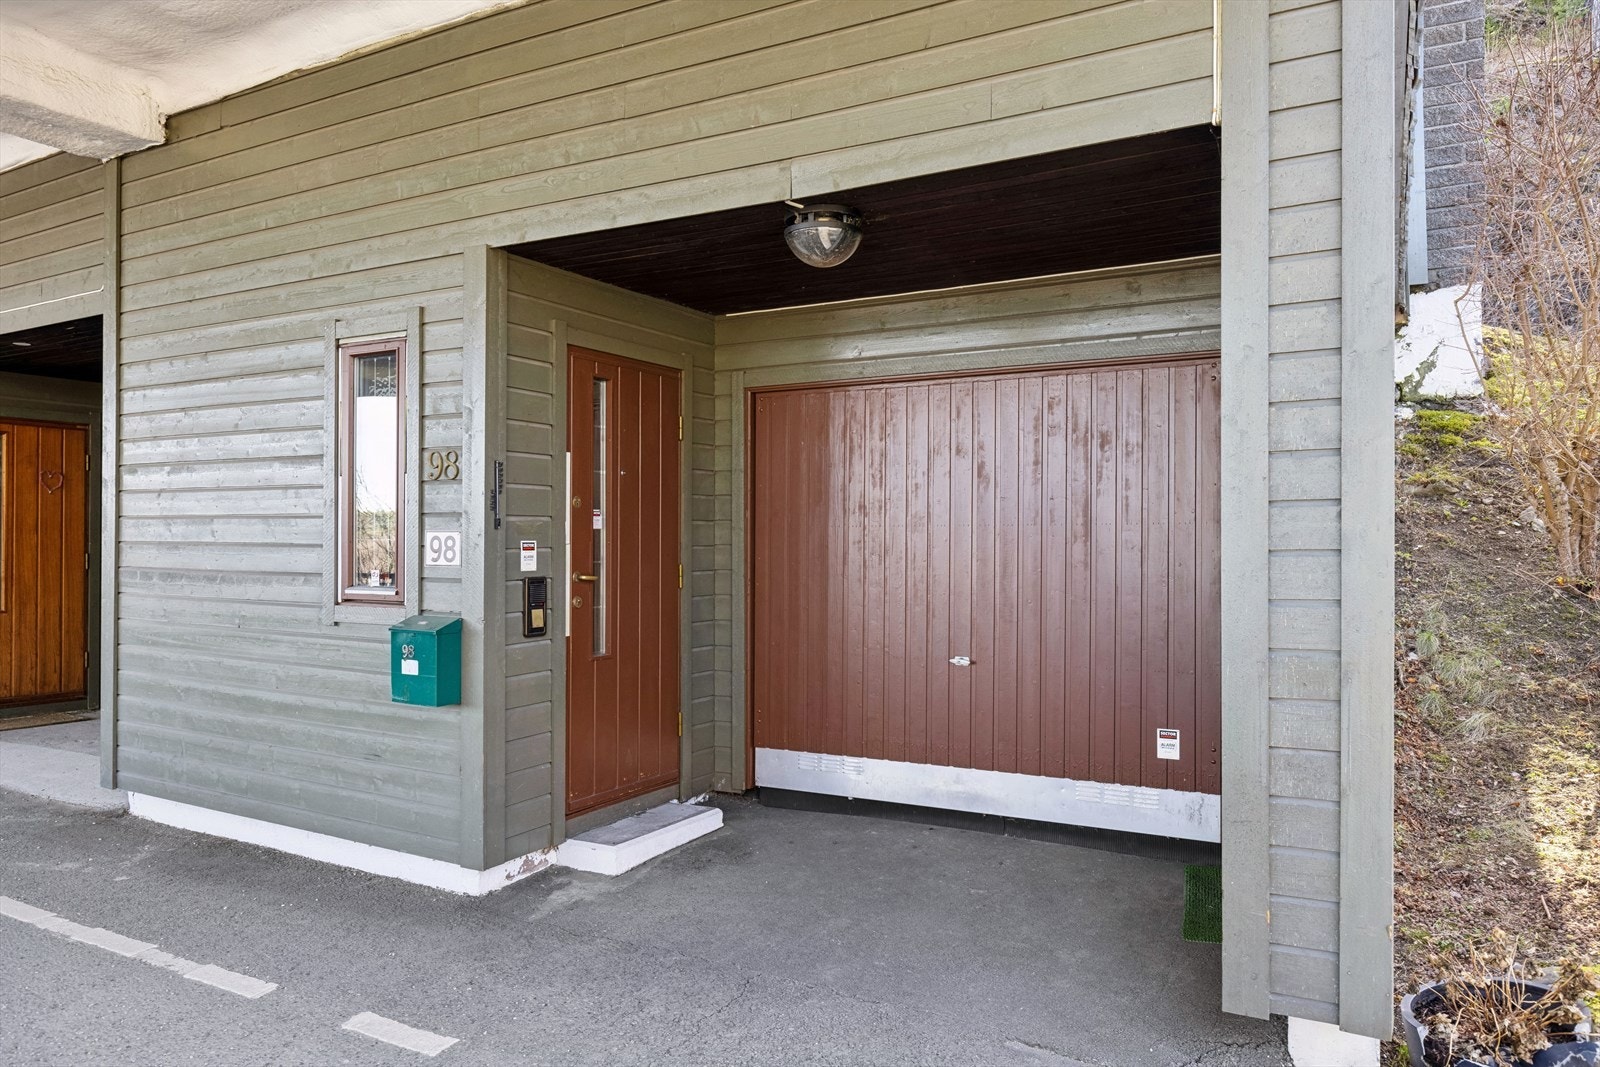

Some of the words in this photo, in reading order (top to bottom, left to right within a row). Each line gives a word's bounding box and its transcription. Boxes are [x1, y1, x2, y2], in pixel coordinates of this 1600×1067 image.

[429, 449, 460, 481] 98
[429, 535, 457, 563] 98
[401, 644, 415, 658] 98
